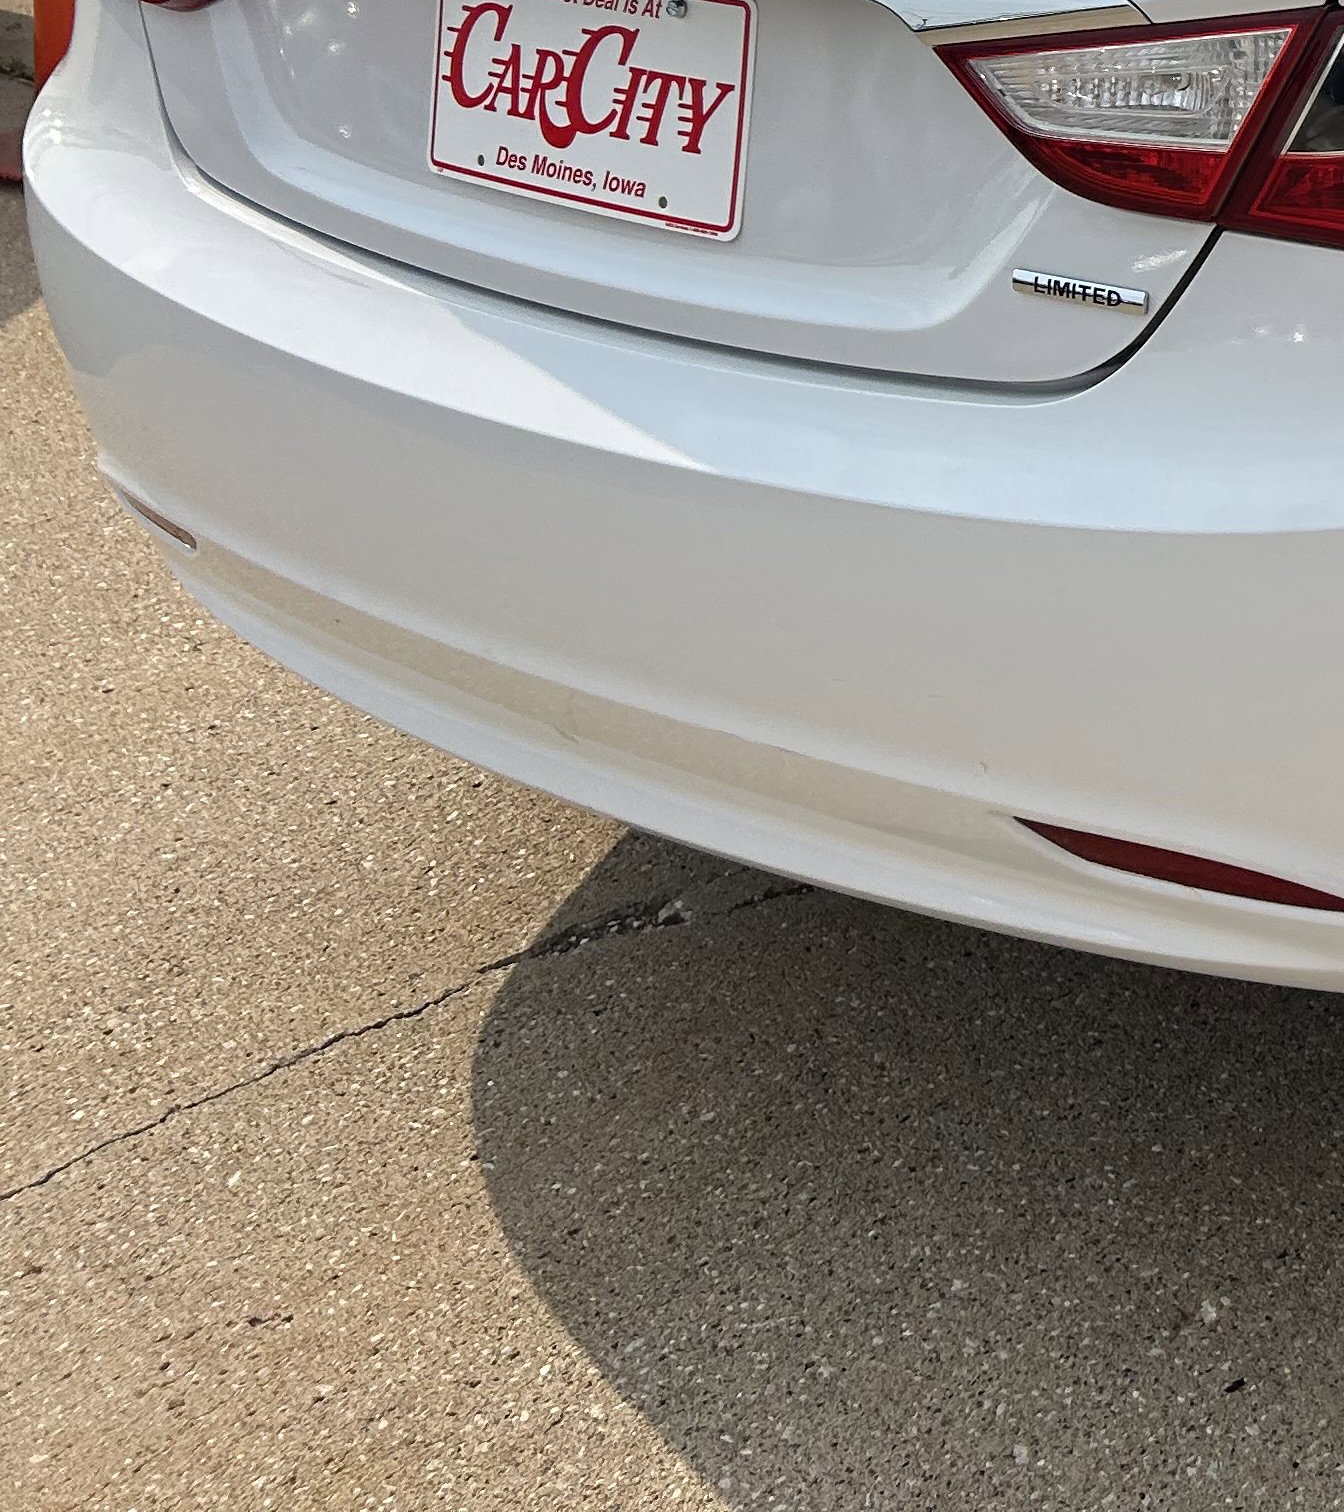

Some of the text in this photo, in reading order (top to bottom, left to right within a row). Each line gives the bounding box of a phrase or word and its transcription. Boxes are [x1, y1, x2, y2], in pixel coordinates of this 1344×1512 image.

[495, 145, 647, 198] Des Moines, Iowa
[1034, 276, 1122, 306] LIMITED
